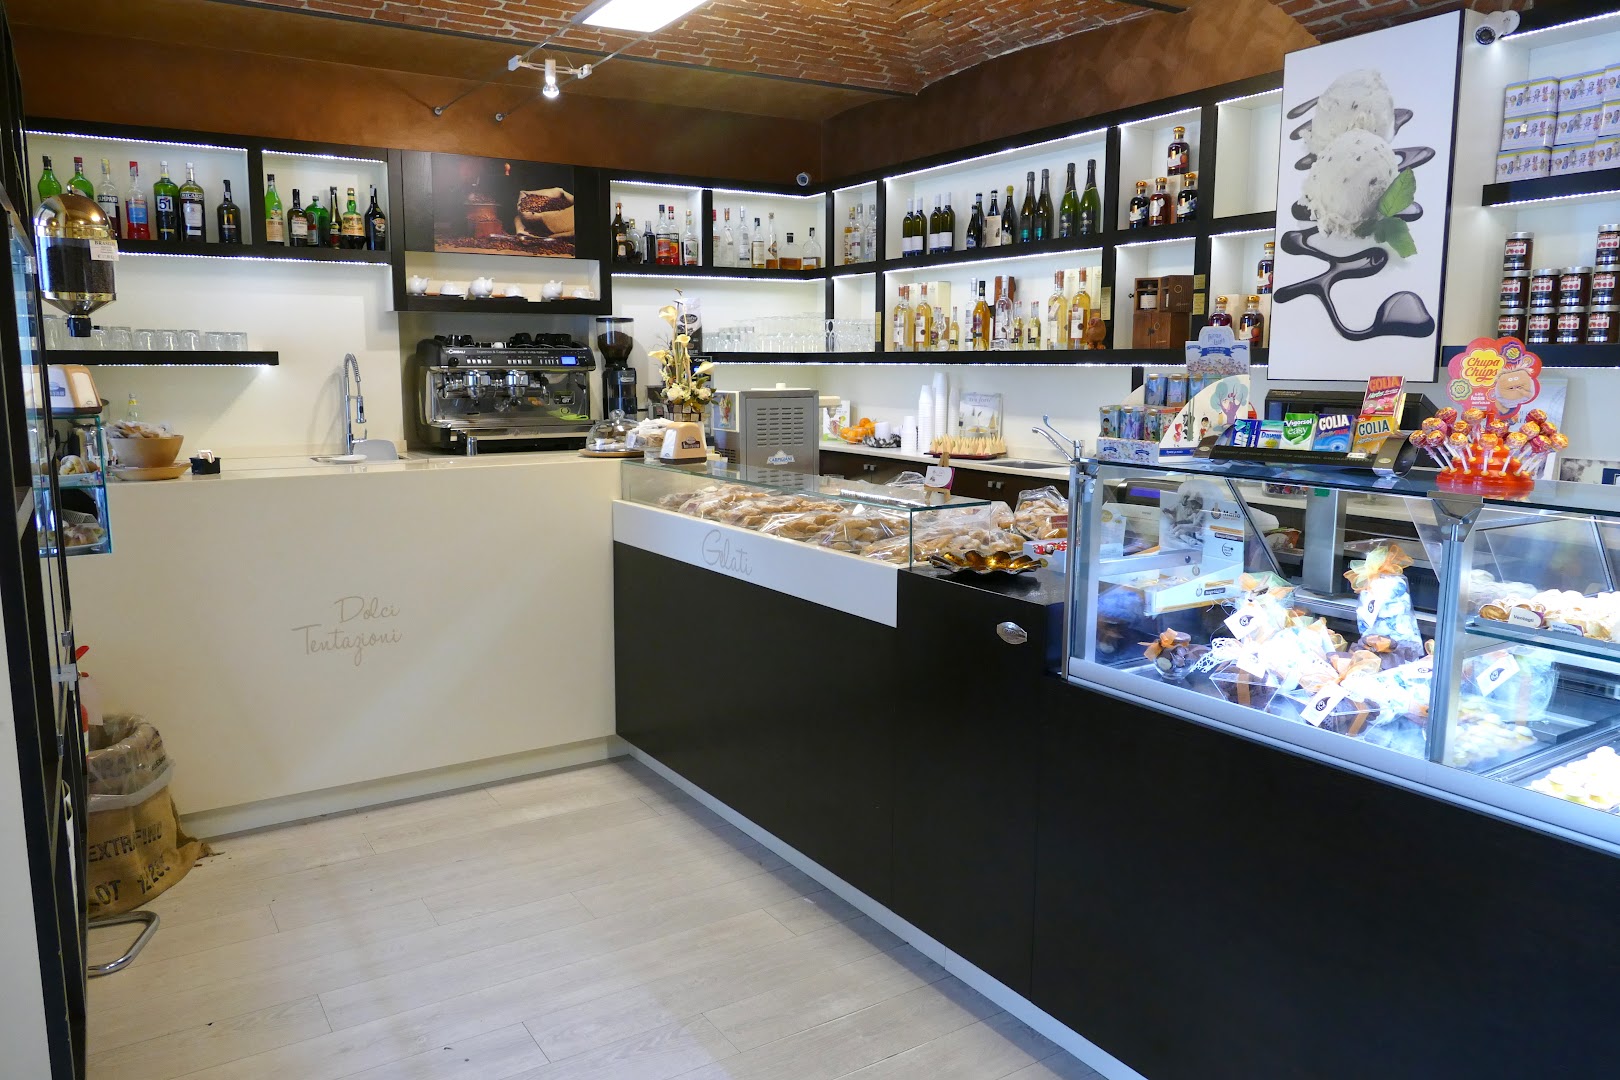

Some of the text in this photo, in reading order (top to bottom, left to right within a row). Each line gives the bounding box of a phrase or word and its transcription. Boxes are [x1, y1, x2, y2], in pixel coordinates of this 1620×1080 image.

[159, 198, 172, 210] 51
[1467, 357, 1501, 368] Chupa
[1465, 367, 1498, 382] Chups
[1369, 376, 1400, 392] GOLIA
[1283, 417, 1314, 427] Vigorsol
[1319, 414, 1351, 431] GOLIA
[1358, 419, 1391, 437] GOLIA
[1287, 425, 1308, 437] easy
[701, 529, 753, 576] Gelati
[333, 595, 401, 624] Dolci
[291, 623, 403, 667] Tentazioni
